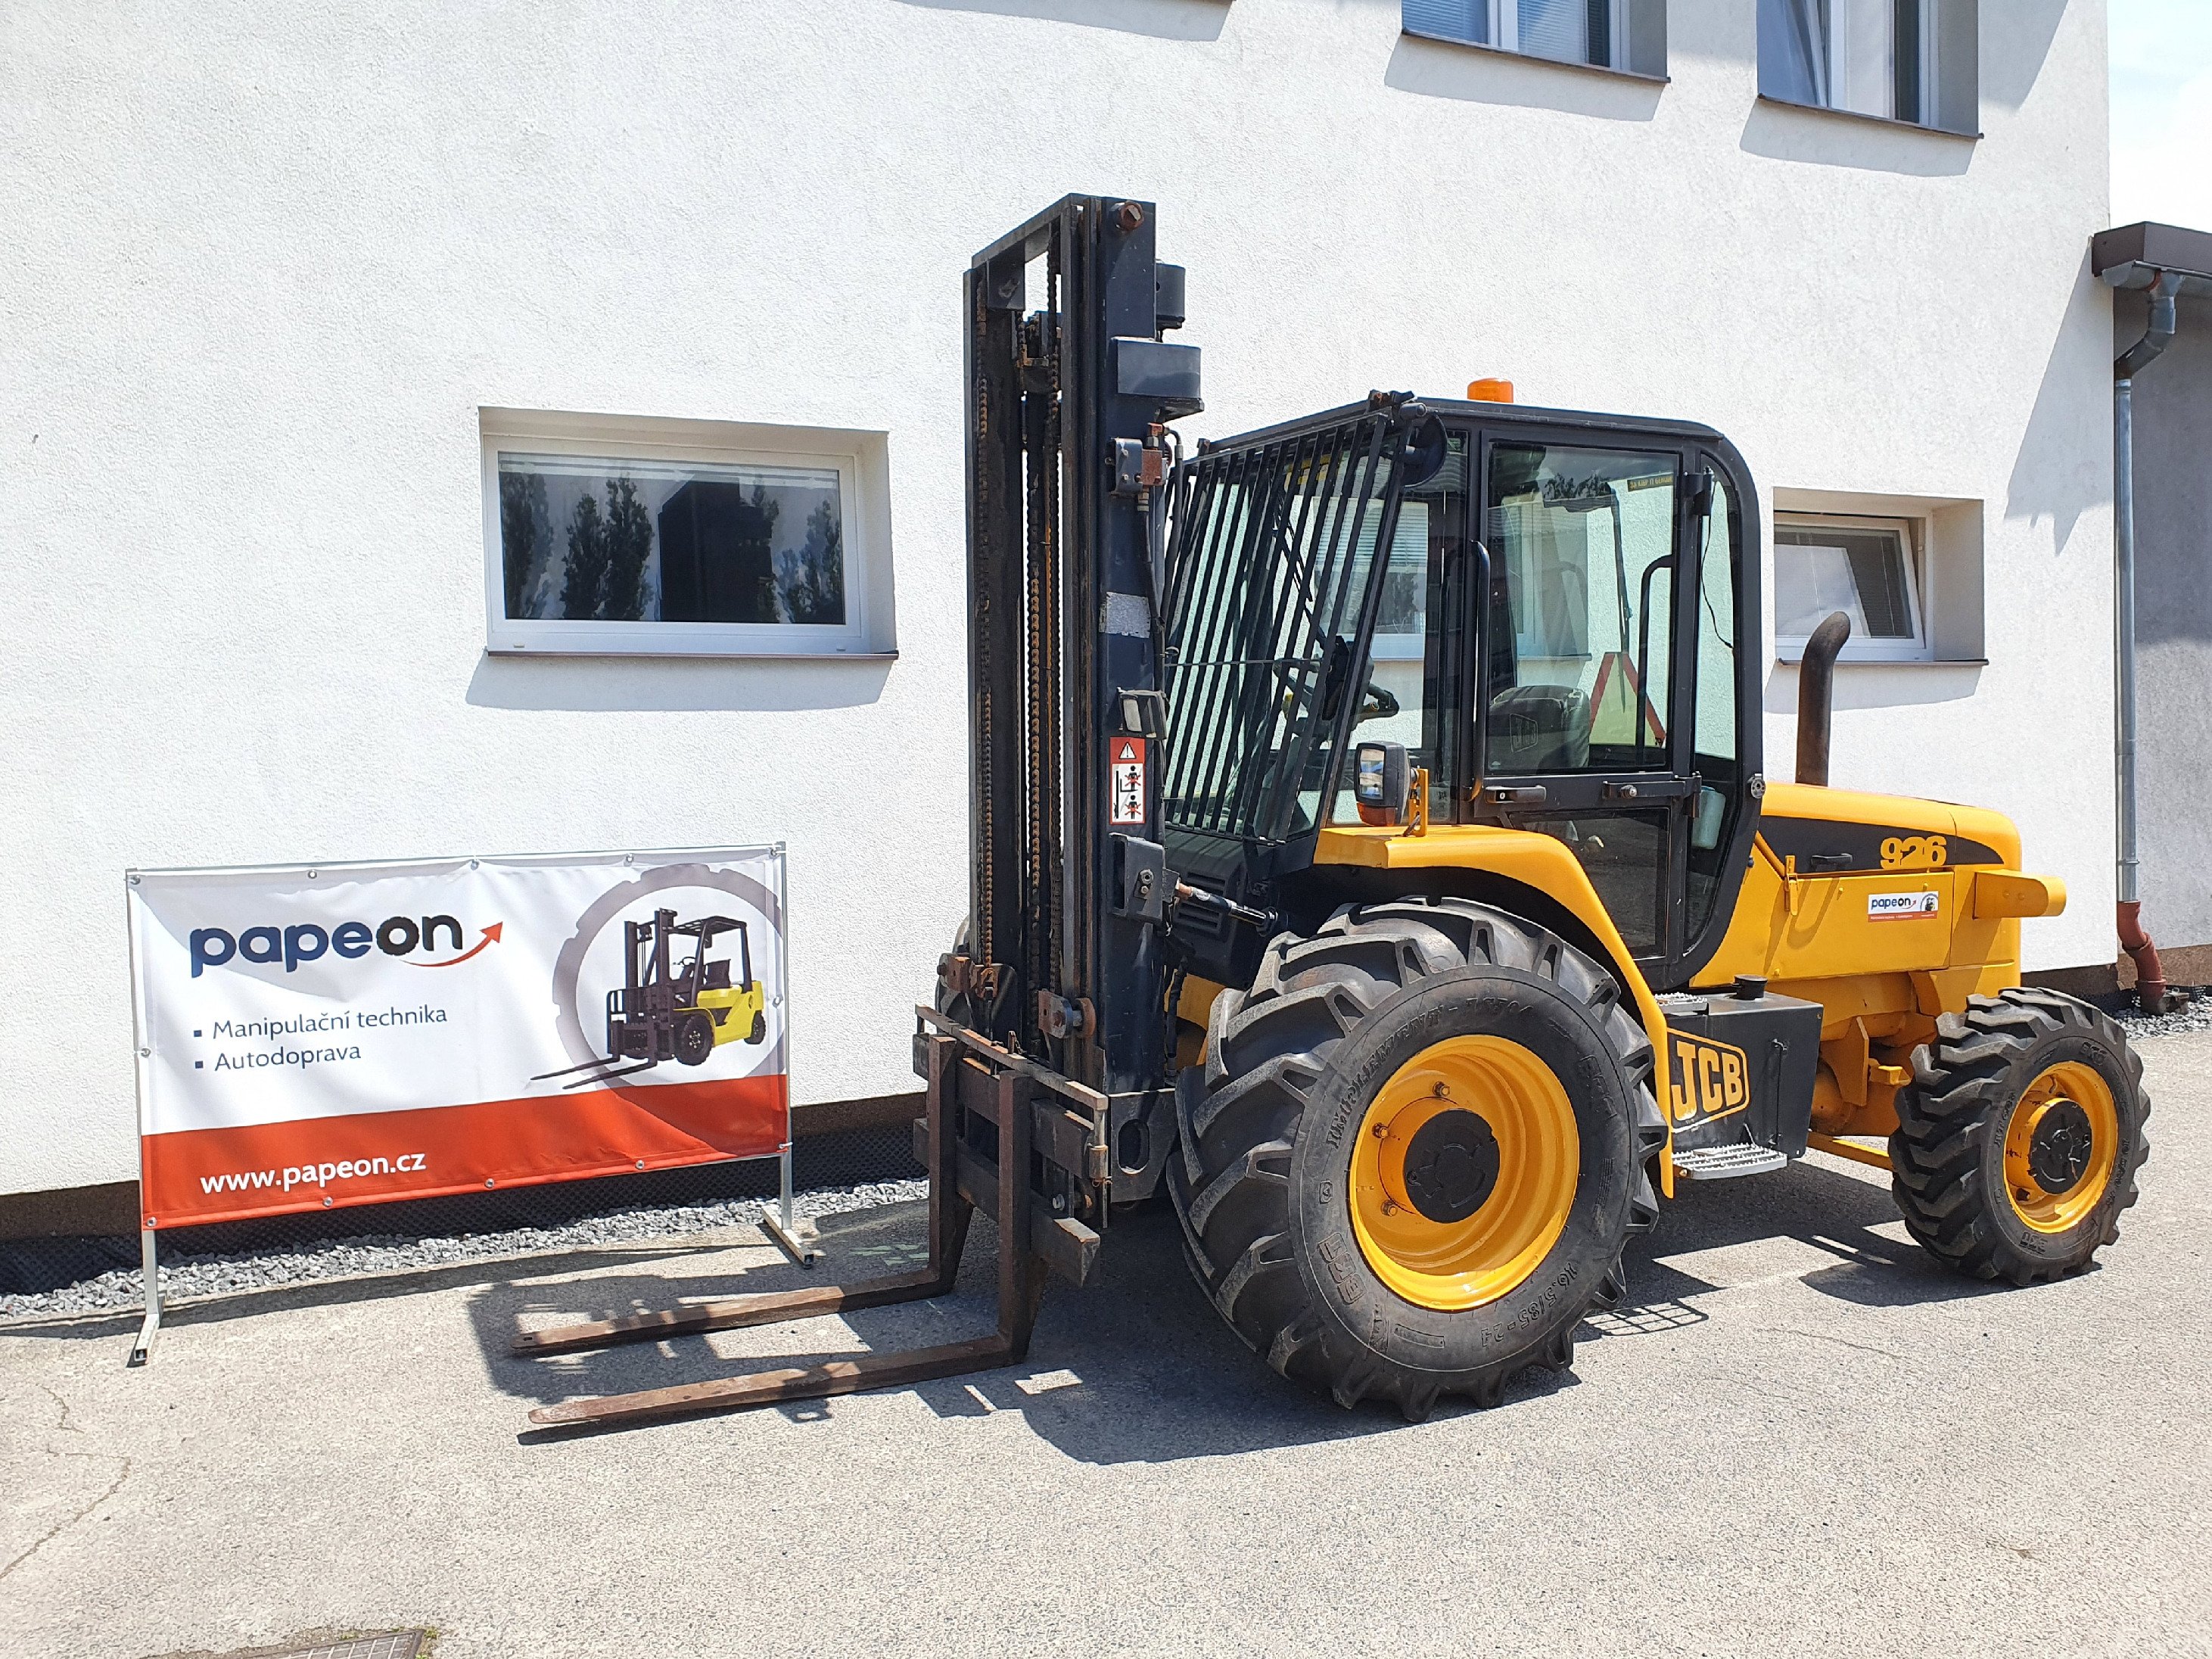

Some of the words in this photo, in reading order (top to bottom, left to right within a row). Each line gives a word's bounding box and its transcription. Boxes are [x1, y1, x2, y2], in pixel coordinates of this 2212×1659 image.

[1881, 836, 1947, 869] 926
[1871, 898, 1911, 910] papeon
[190, 914, 463, 979] papeon
[213, 1010, 350, 1040] Manipulační
[357, 1004, 448, 1028] technika
[214, 1044, 362, 1072] Autodoprava
[1326, 1004, 1443, 1149] IMPLEMENT
[1671, 1041, 1744, 1121] JCB
[200, 1151, 426, 1194] www.papeon.cz
